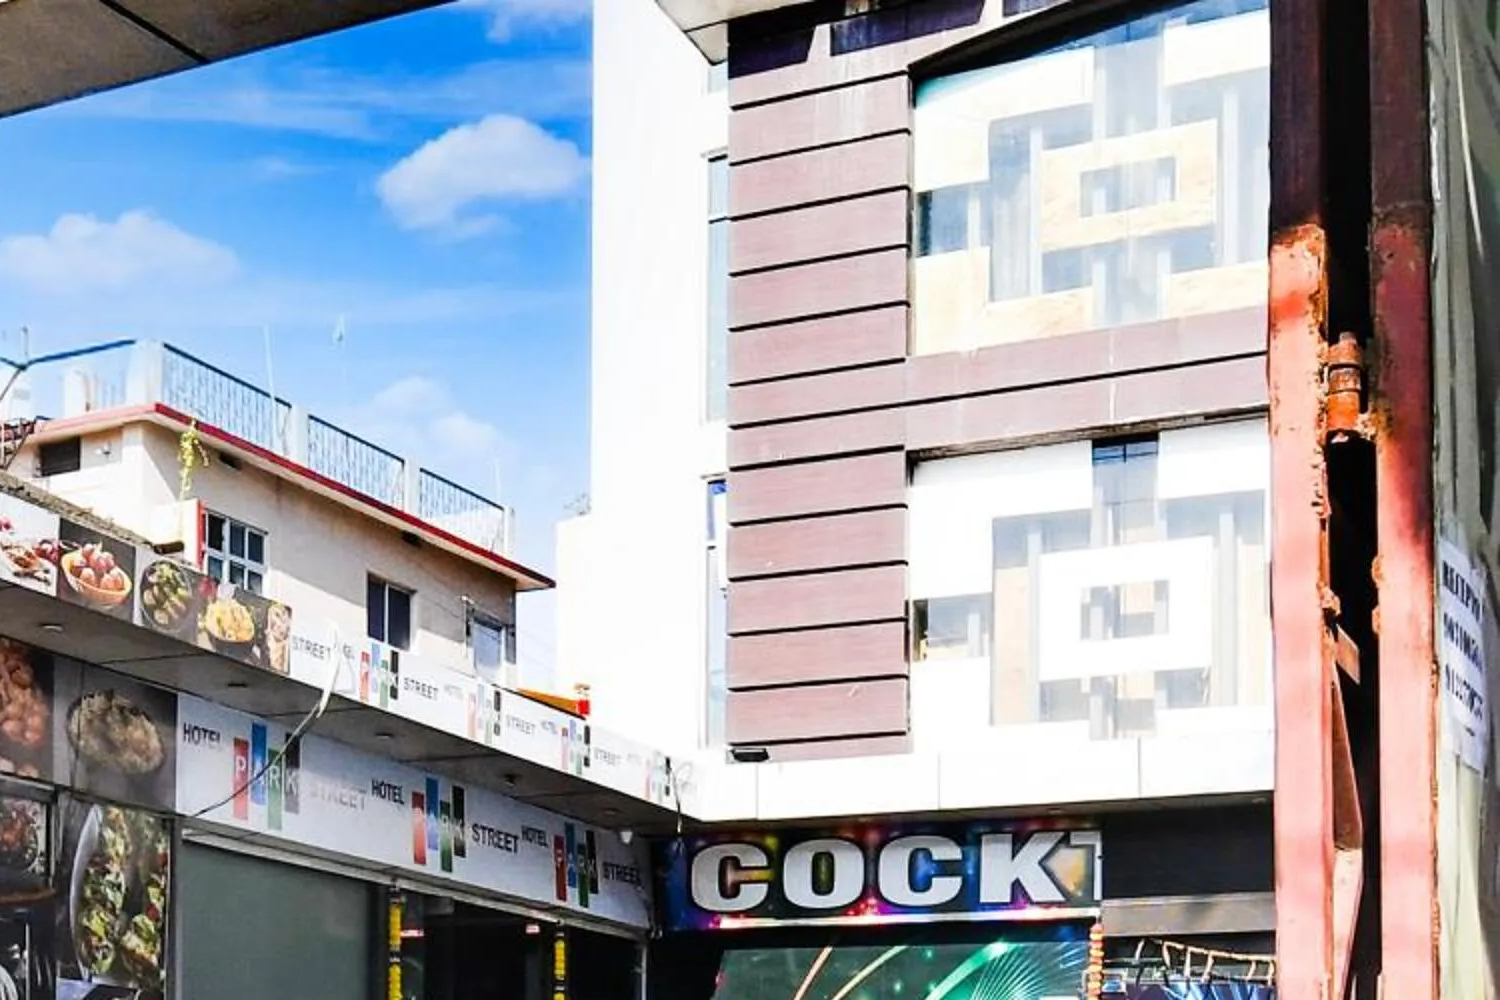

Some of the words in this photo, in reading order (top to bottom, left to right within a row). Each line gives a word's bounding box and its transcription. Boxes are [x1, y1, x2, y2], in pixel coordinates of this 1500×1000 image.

[371, 779, 405, 806] HOTEL
[472, 823, 520, 855] STREET
[521, 824, 549, 849] HOTEL
